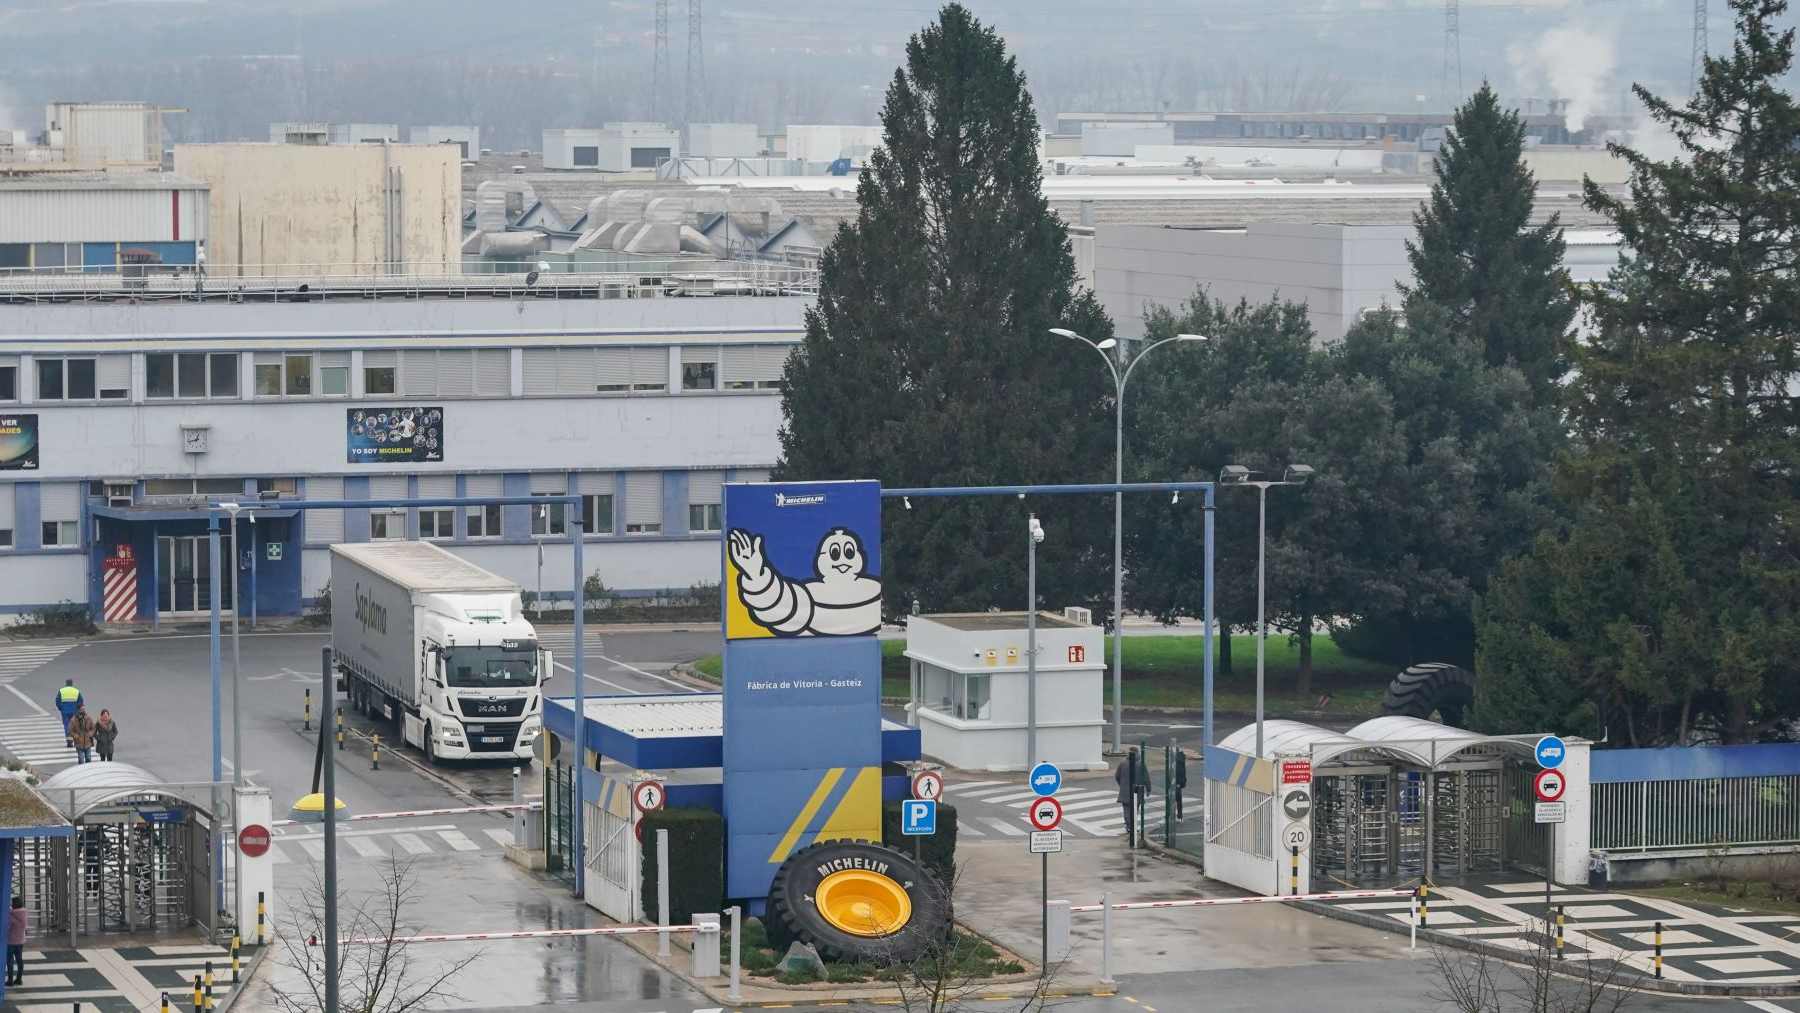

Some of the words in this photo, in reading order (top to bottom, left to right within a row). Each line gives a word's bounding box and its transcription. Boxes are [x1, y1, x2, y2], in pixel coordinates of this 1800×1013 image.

[786, 496, 824, 504] MICHELIN
[747, 680, 778, 690] Fábrica
[780, 680, 791, 689] de
[793, 680, 823, 689] Vitoria
[830, 679, 862, 688] Gasteiz
[911, 803, 928, 827] P
[1290, 831, 1305, 843] 20
[817, 857, 889, 877] MICHELIN
